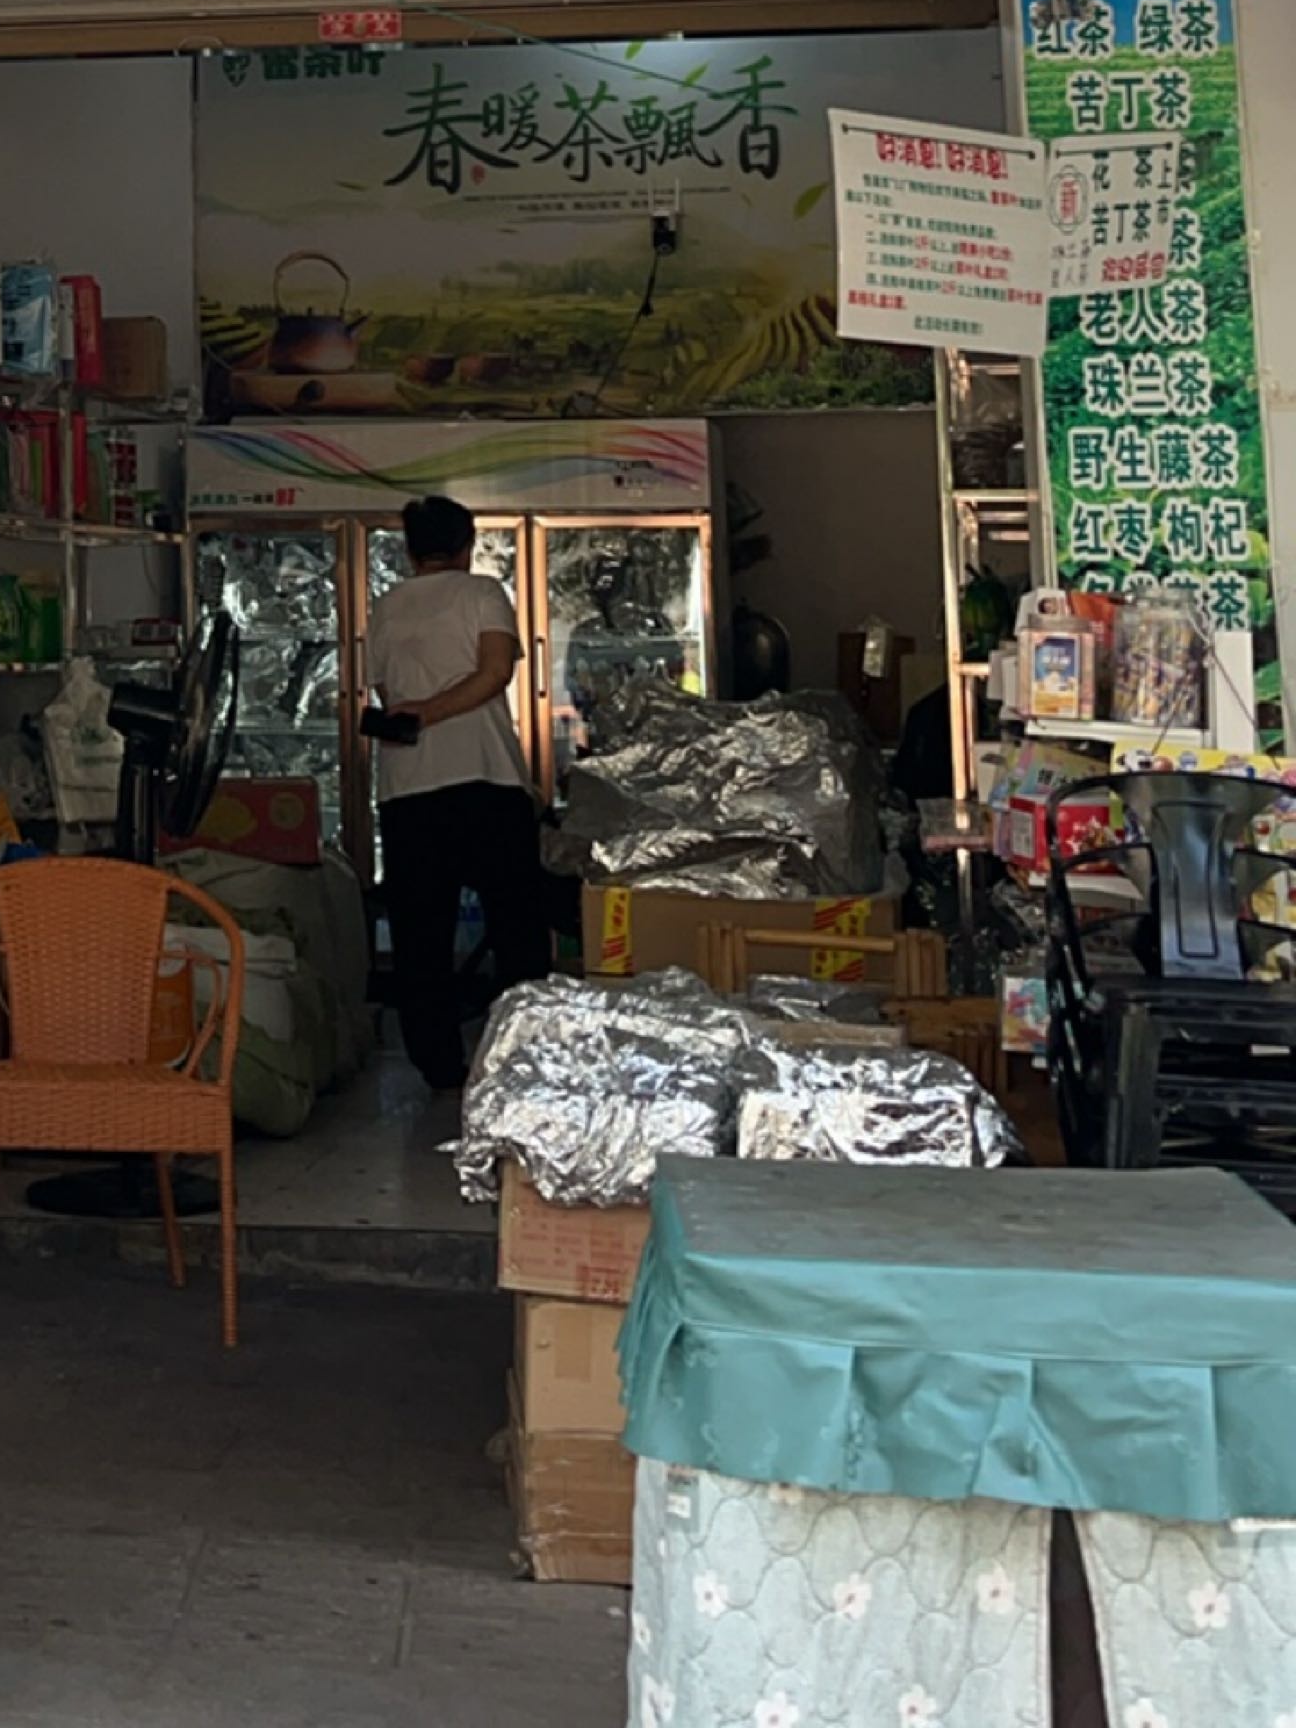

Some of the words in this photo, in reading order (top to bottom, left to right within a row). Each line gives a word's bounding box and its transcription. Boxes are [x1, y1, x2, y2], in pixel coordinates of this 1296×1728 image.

[1068, 67, 1191, 131] 苦丁茶
[1091, 200, 1153, 246] 苦丁茶
[1080, 280, 1206, 346] 老人茶
[1083, 351, 1211, 417] 珠兰茶
[1067, 423, 1240, 490] 野生藤茶
[1070, 500, 1153, 563] 红枣
[1163, 496, 1251, 562] 枸杞
